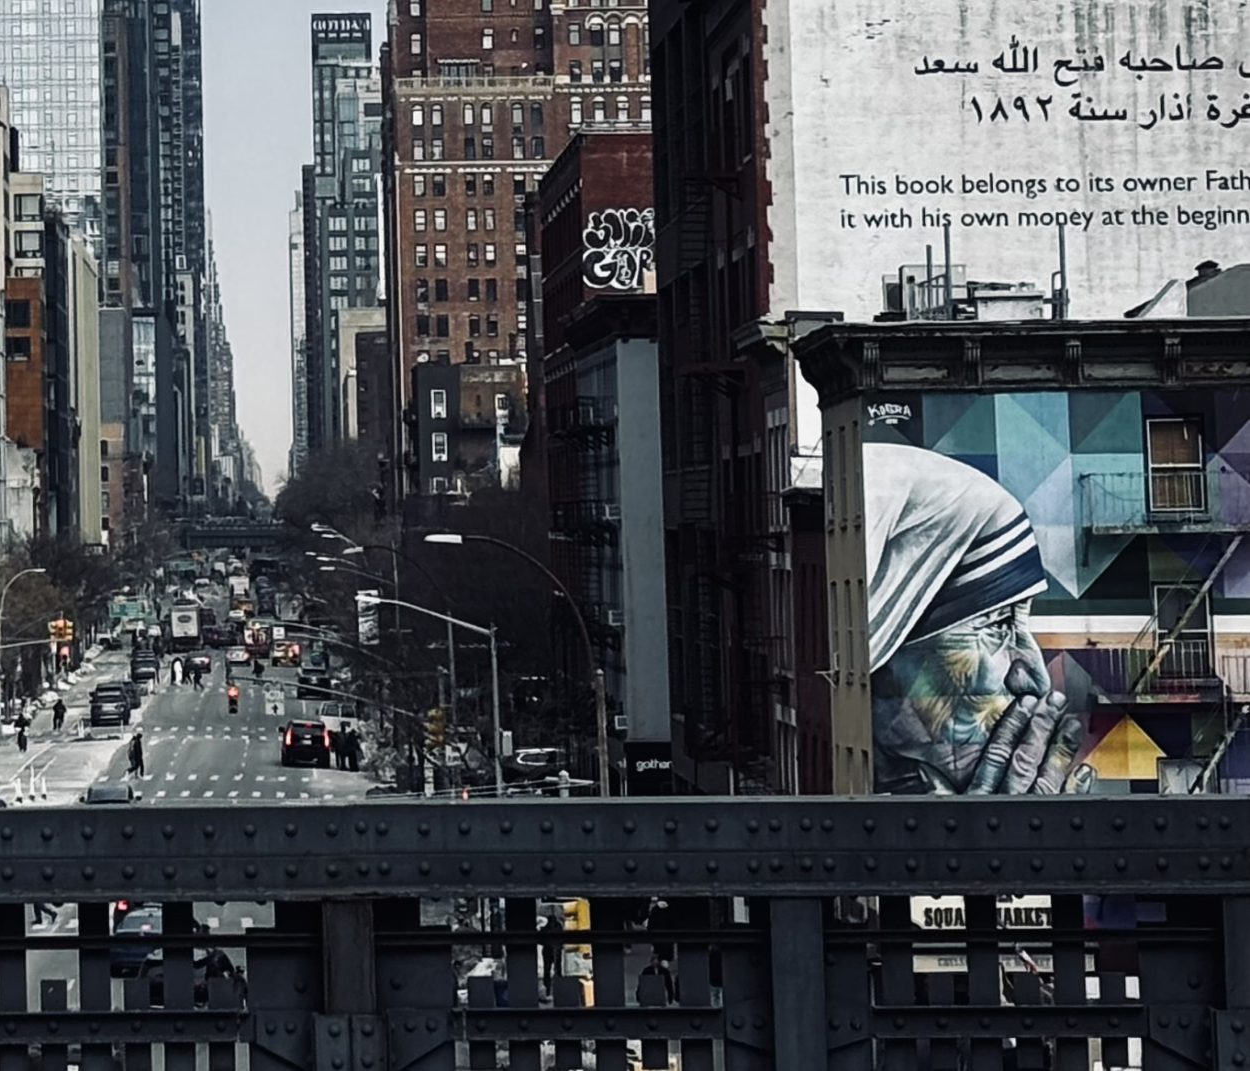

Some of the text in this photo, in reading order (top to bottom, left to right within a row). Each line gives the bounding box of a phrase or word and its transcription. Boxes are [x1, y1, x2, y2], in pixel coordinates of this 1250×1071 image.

[914, 55, 979, 75] سعد
[971, 94, 1053, 123] ١٨٩٢
[1068, 92, 1127, 121] سنة
[838, 169, 1250, 199] This book belongs to its owner Fath
[840, 204, 1250, 232] it with his own money at the beginn
